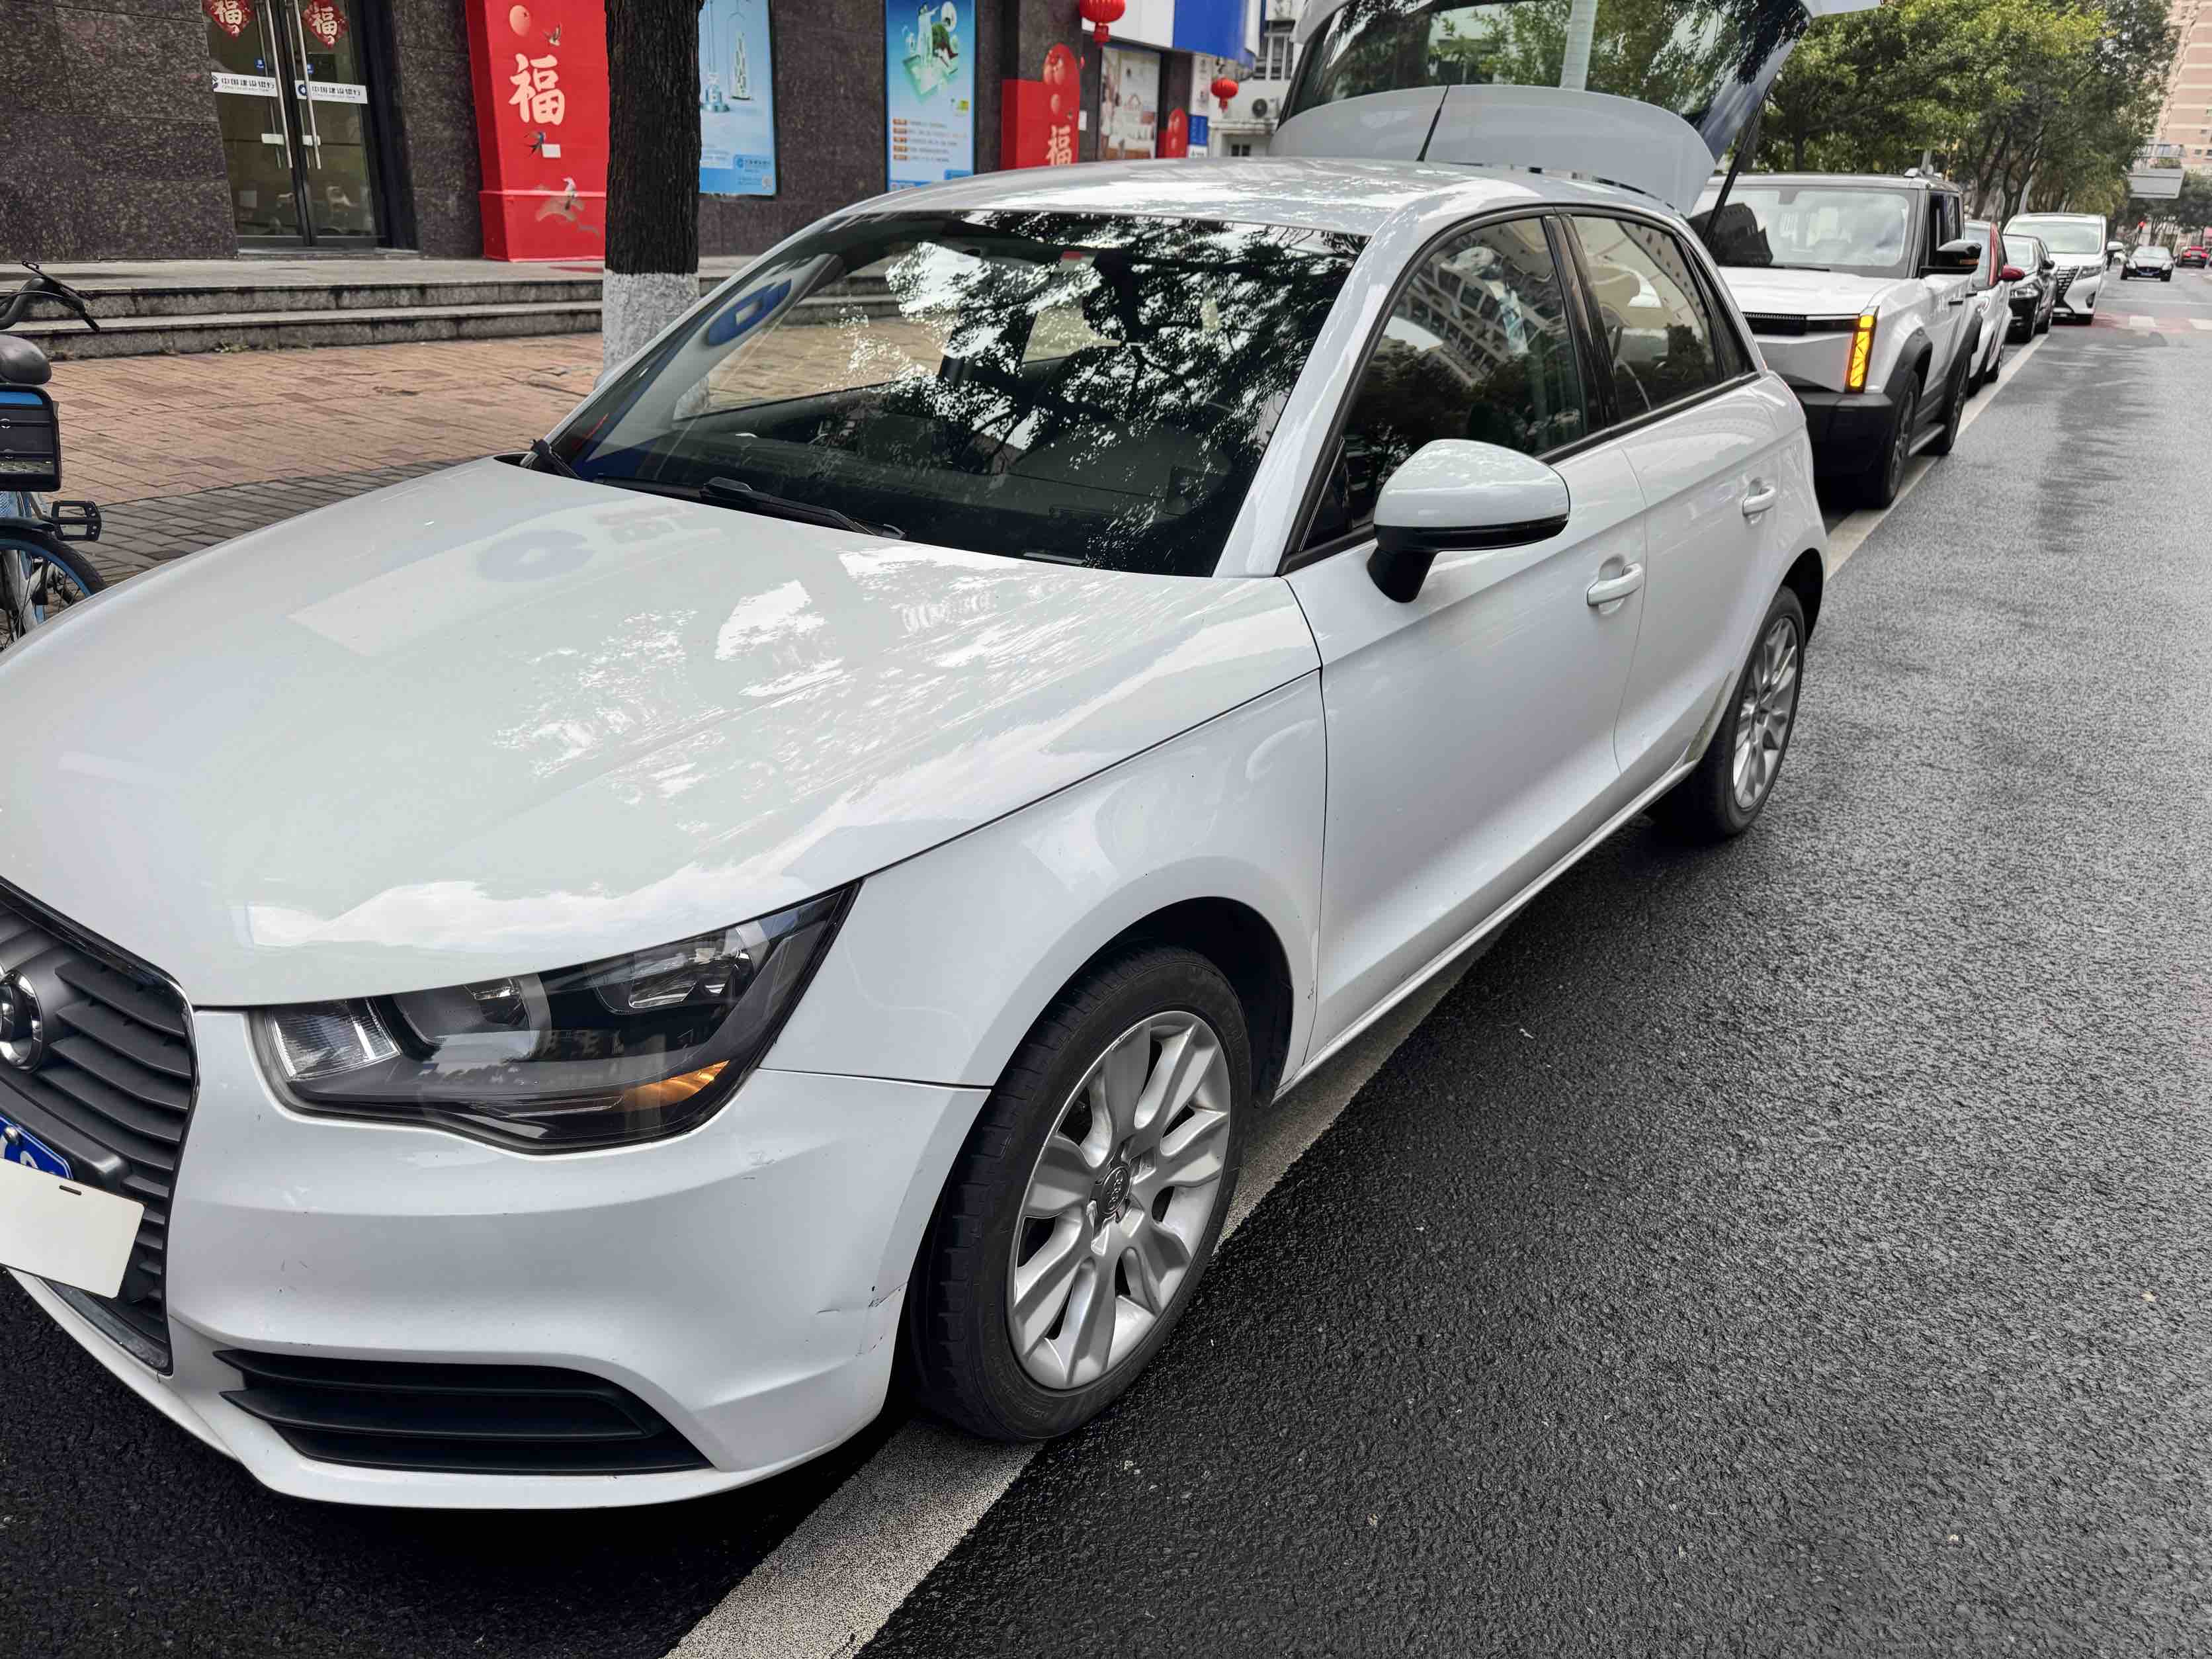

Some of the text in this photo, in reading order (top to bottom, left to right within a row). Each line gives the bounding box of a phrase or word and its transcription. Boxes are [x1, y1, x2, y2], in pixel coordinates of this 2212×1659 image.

[312, 3, 338, 36] 福
[508, 54, 566, 126] 福
[1046, 125, 1072, 165] 福
